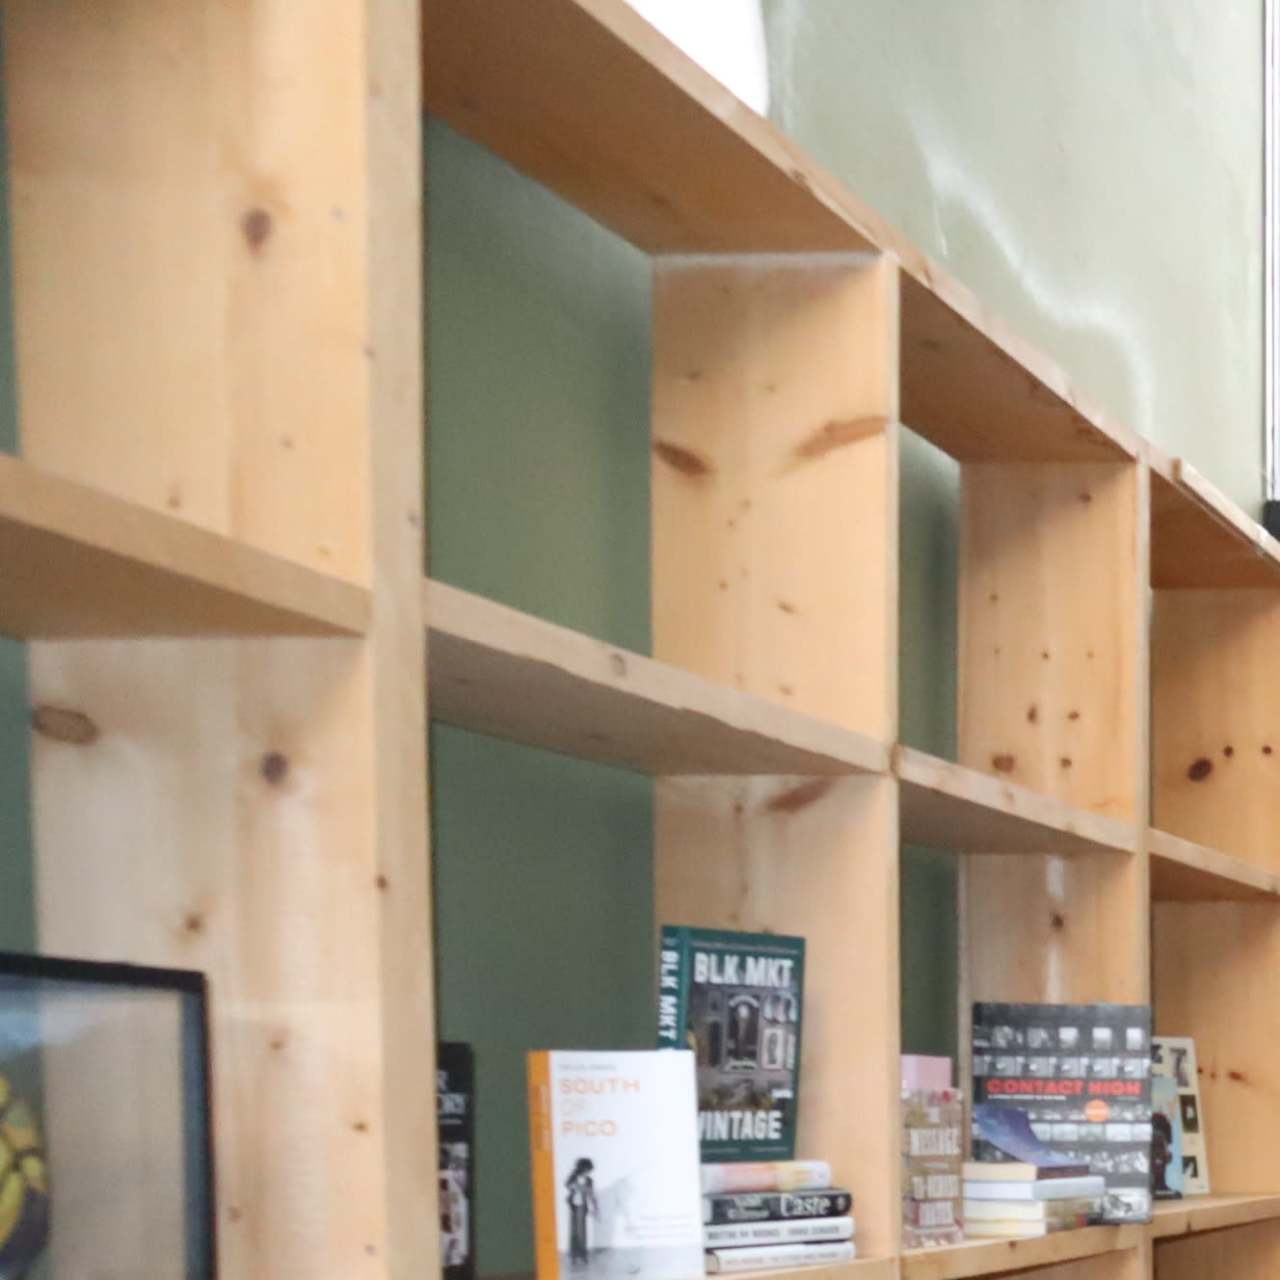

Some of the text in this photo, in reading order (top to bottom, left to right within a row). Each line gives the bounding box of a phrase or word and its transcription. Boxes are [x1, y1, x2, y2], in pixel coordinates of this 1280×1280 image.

[694, 952, 794, 988] BLK MKT
[659, 951, 679, 1040] BLK MKT
[560, 1077, 641, 1094] SOUTH
[986, 1079, 1142, 1096] CONTACT HIGH
[562, 1120, 617, 1136] PICO
[781, 1193, 831, 1217] Caste
